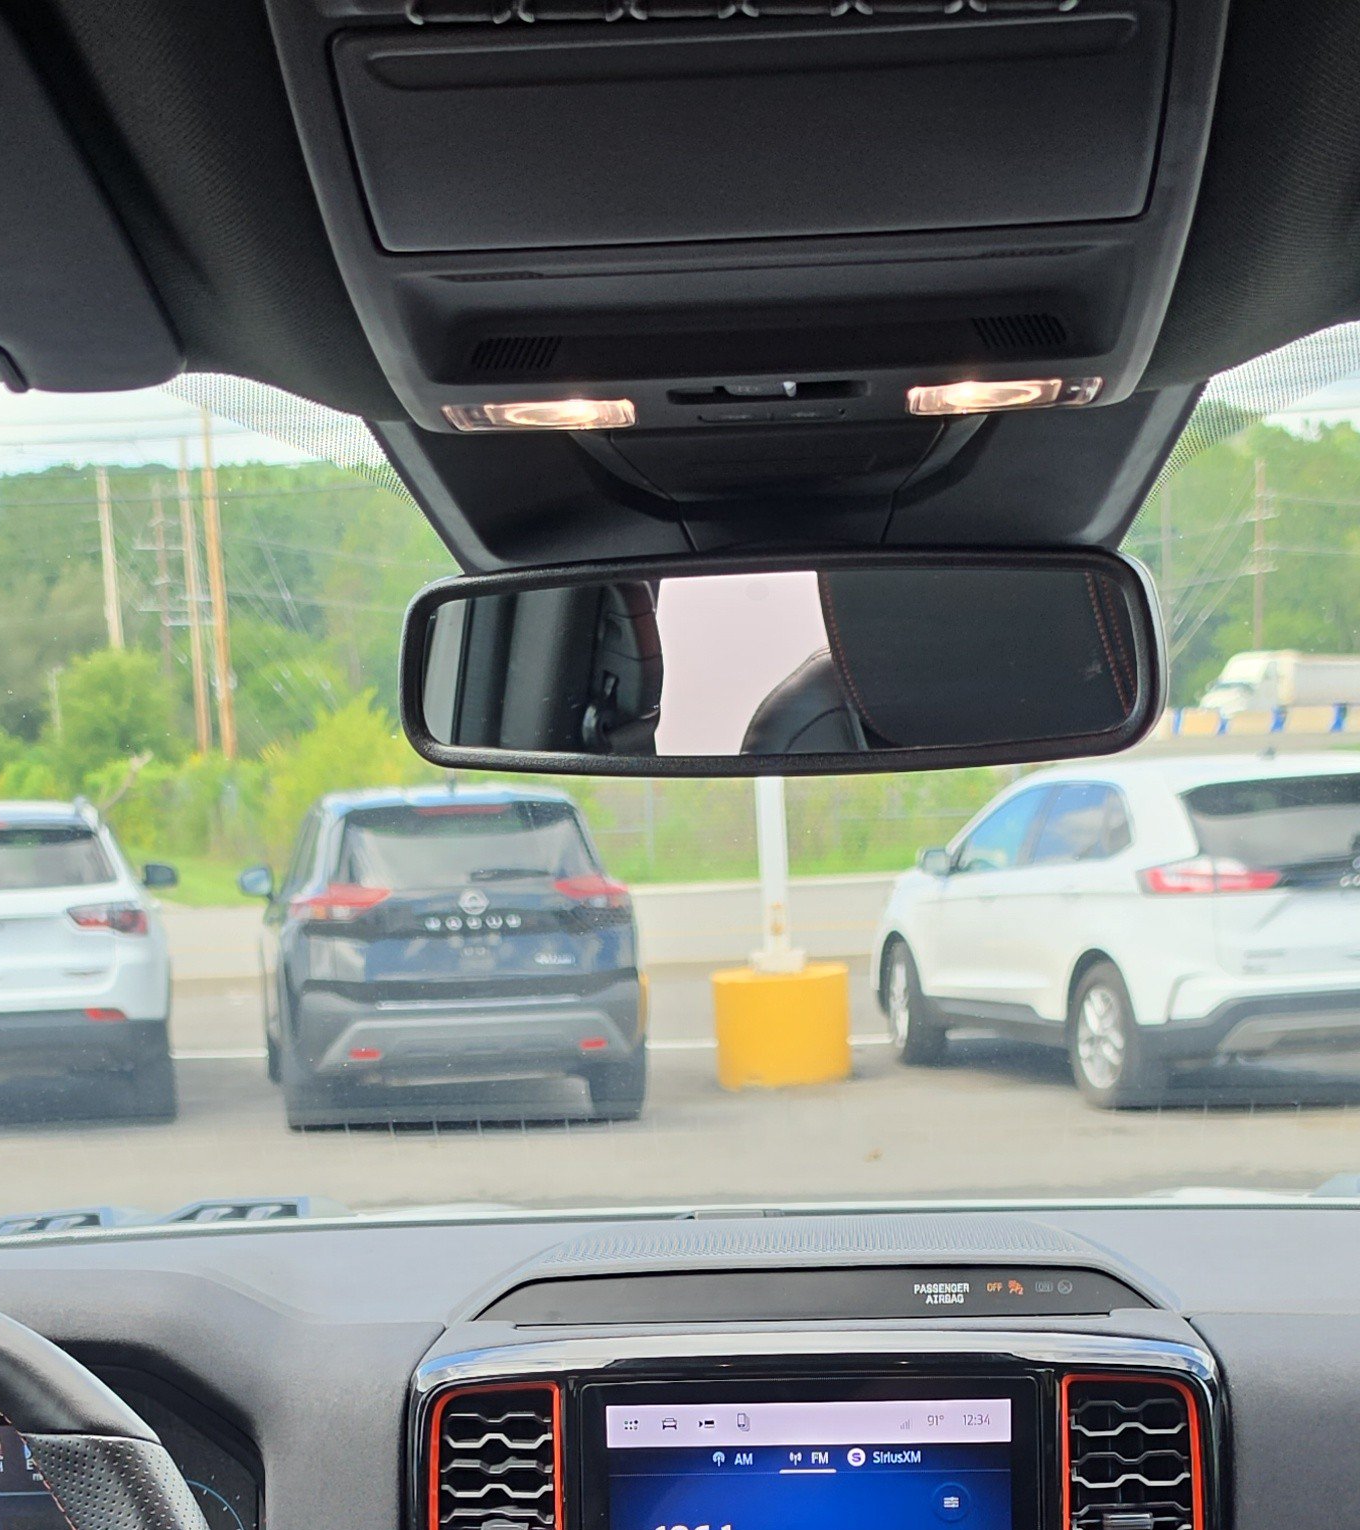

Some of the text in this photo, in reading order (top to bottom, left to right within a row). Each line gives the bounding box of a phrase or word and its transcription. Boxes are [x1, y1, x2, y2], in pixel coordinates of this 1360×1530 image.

[913, 1283, 970, 1295] PASSENGER
[986, 1282, 1003, 1293] OFF
[925, 1294, 965, 1304] AIRBAG
[734, 1452, 753, 1466] AM
[811, 1451, 829, 1465] FM
